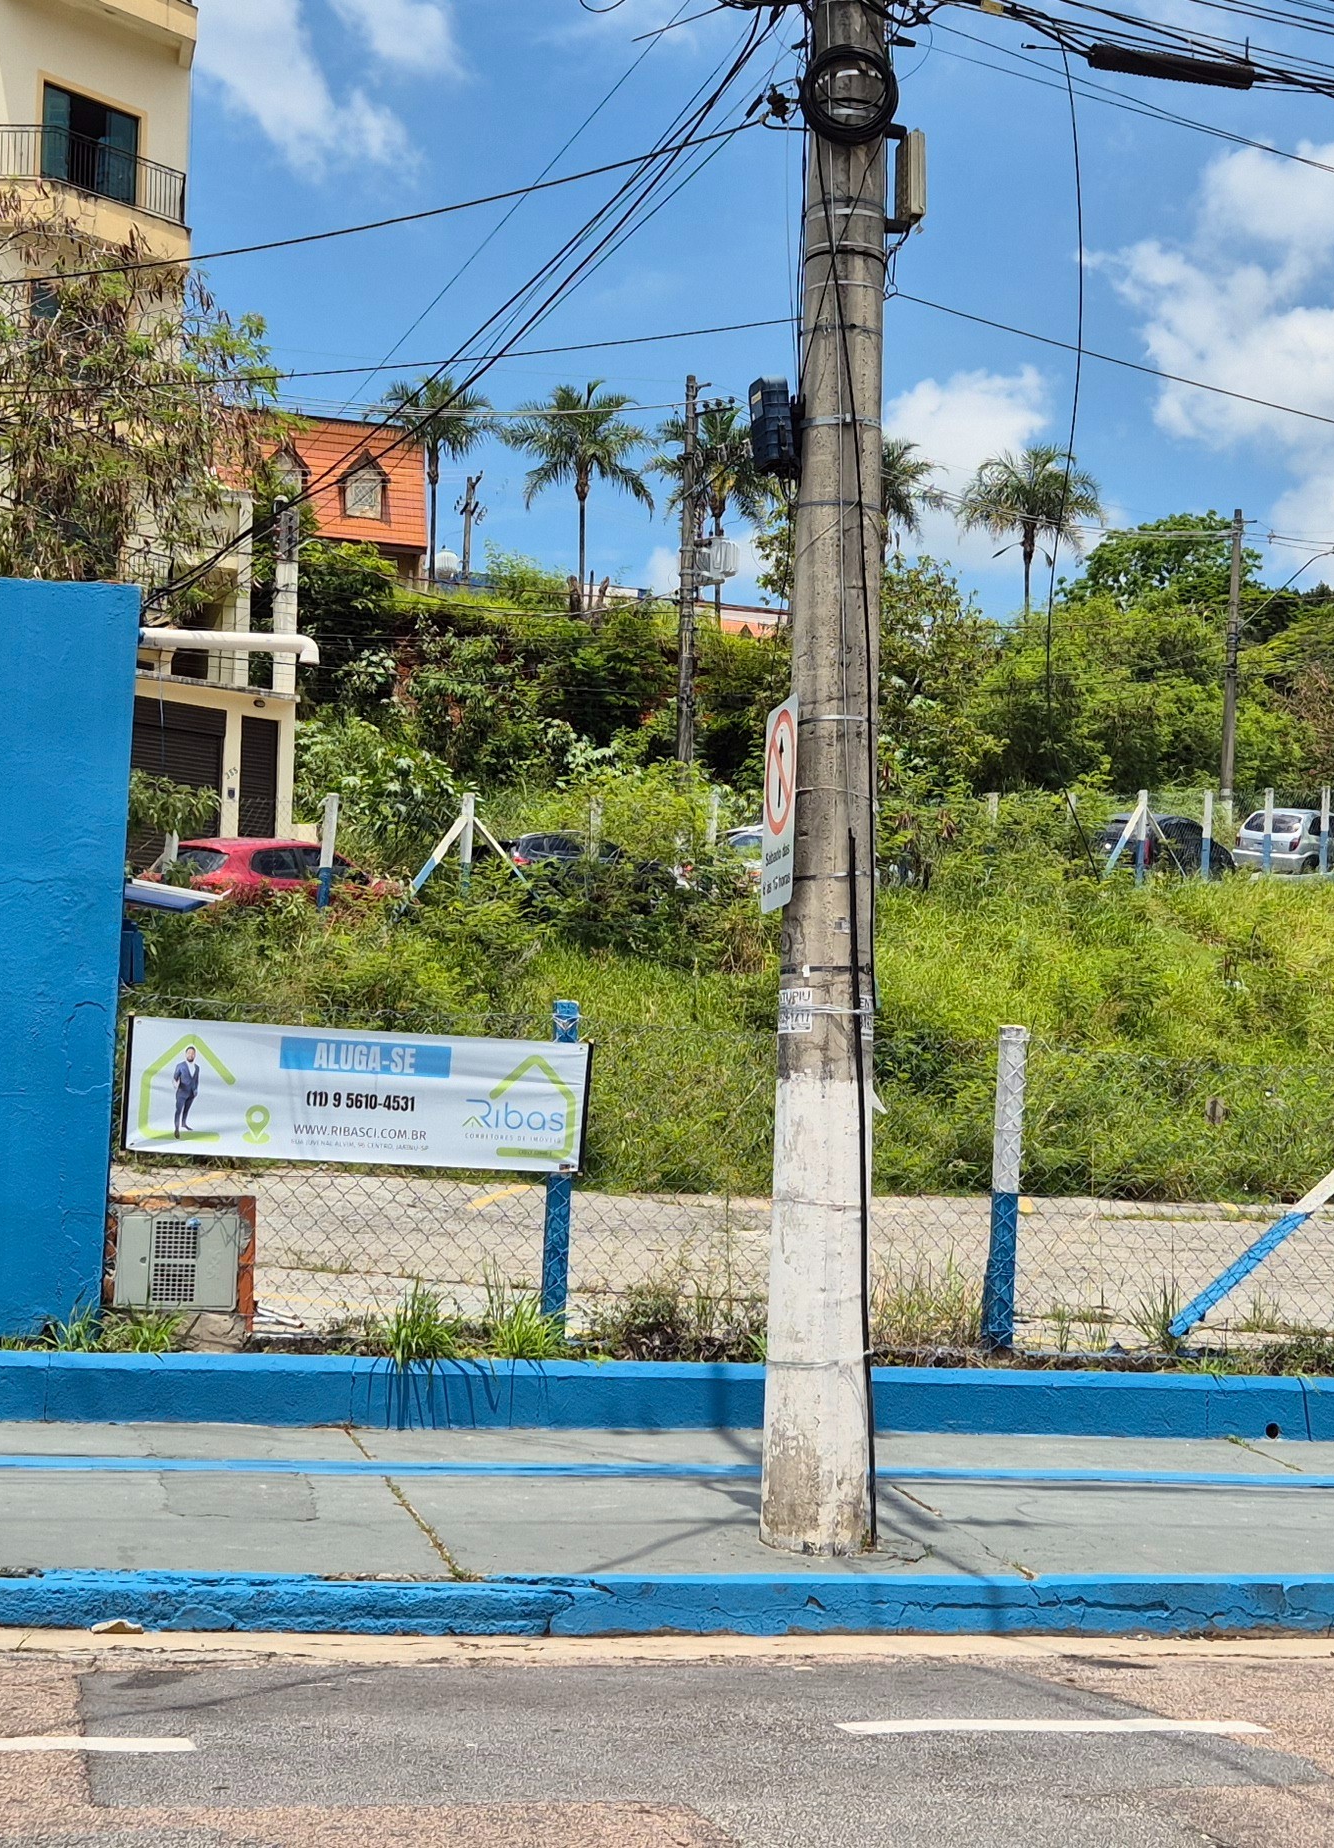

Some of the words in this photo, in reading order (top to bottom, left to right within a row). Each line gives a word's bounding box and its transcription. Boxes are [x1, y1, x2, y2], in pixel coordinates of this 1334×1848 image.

[313, 1042, 417, 1074] ALUGA-SE
[306, 1090, 329, 1107] (11)
[332, 1092, 342, 1108] 9
[345, 1092, 415, 1112] 5610-4531
[464, 1098, 564, 1132] Ribas
[293, 1123, 427, 1141] WWW.RIBASCI.COM.BR
